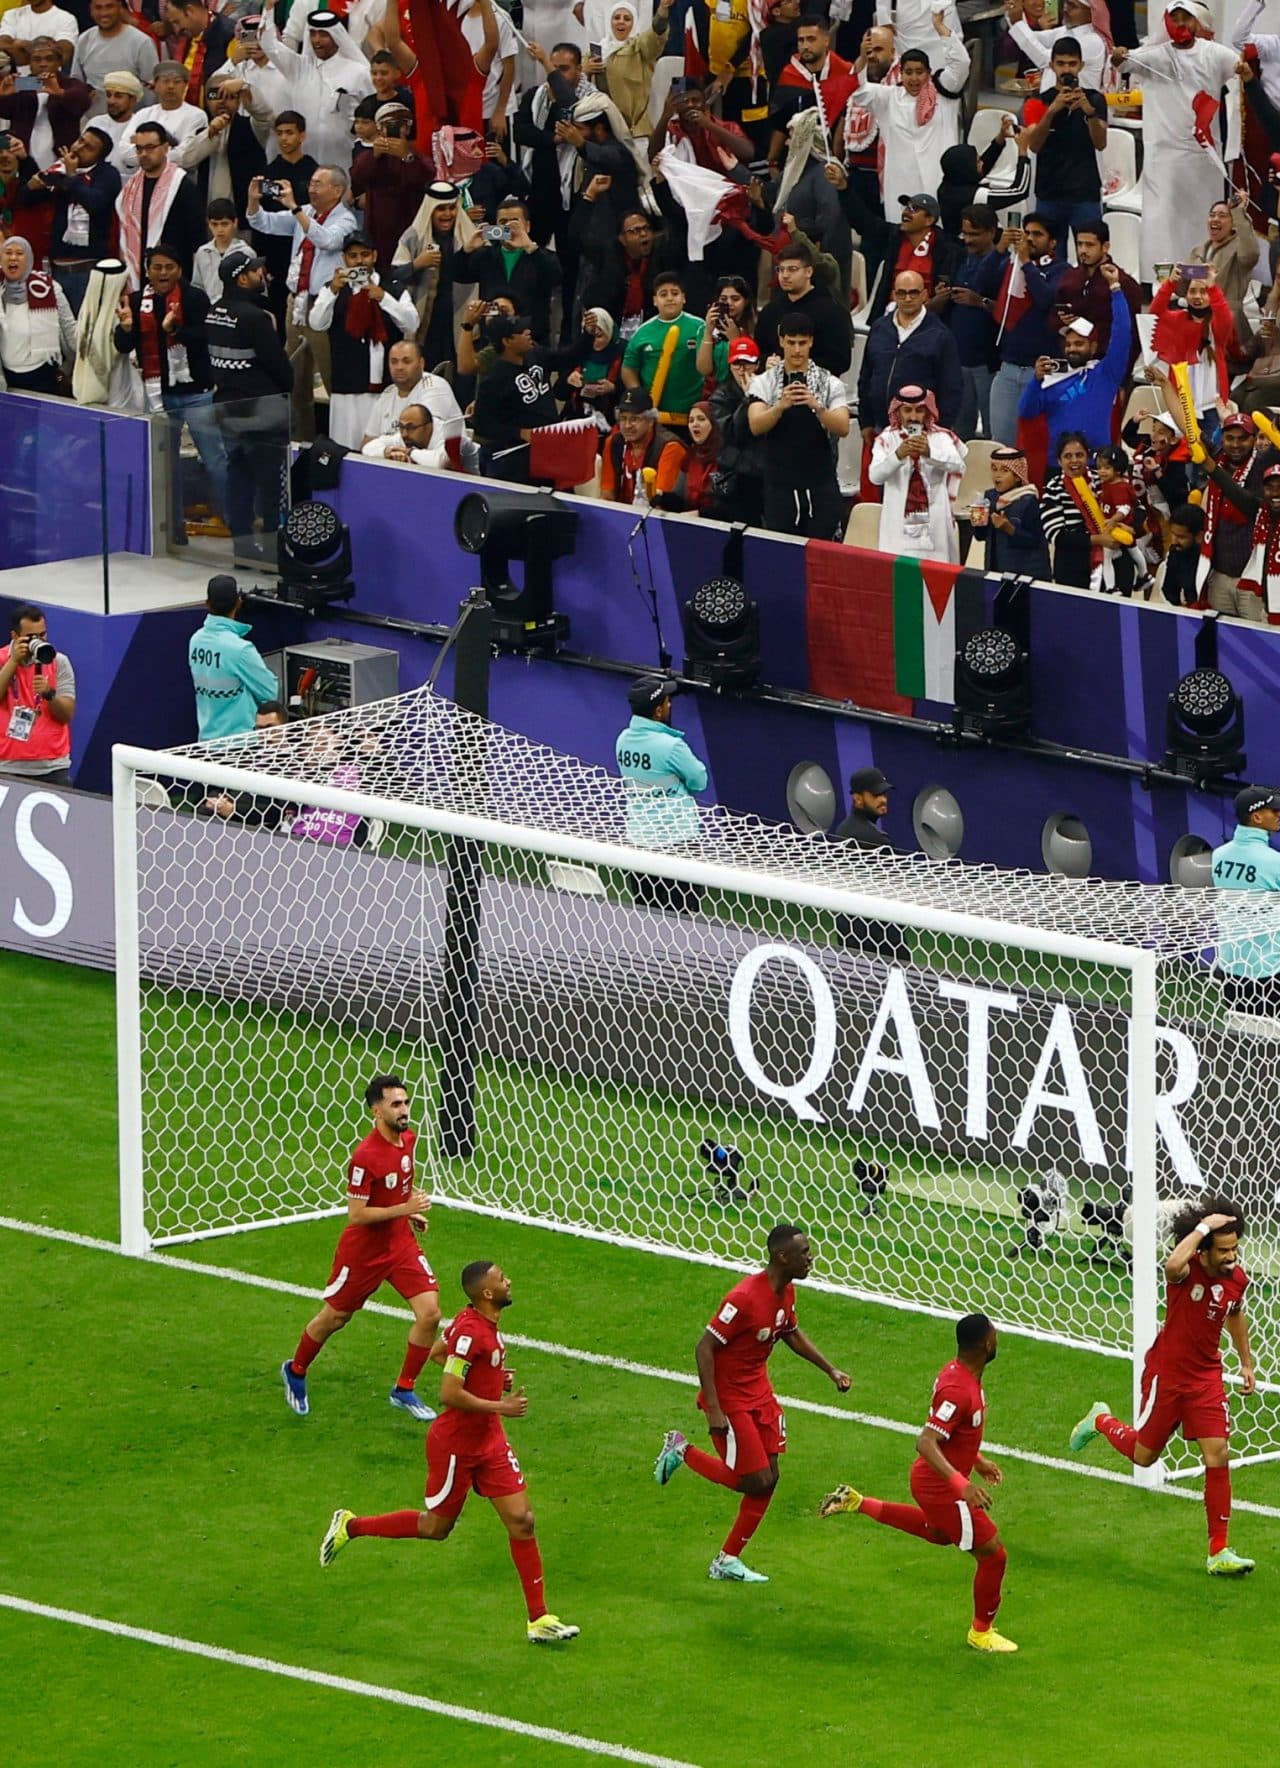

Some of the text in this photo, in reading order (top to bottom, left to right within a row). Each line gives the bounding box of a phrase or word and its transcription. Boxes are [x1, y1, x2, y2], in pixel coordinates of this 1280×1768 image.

[514, 364, 550, 405] 92
[190, 647, 222, 669] 4901
[617, 749, 652, 771] 4898
[1213, 859, 1257, 884] 4778
[727, 942, 1206, 1190] QATAR
